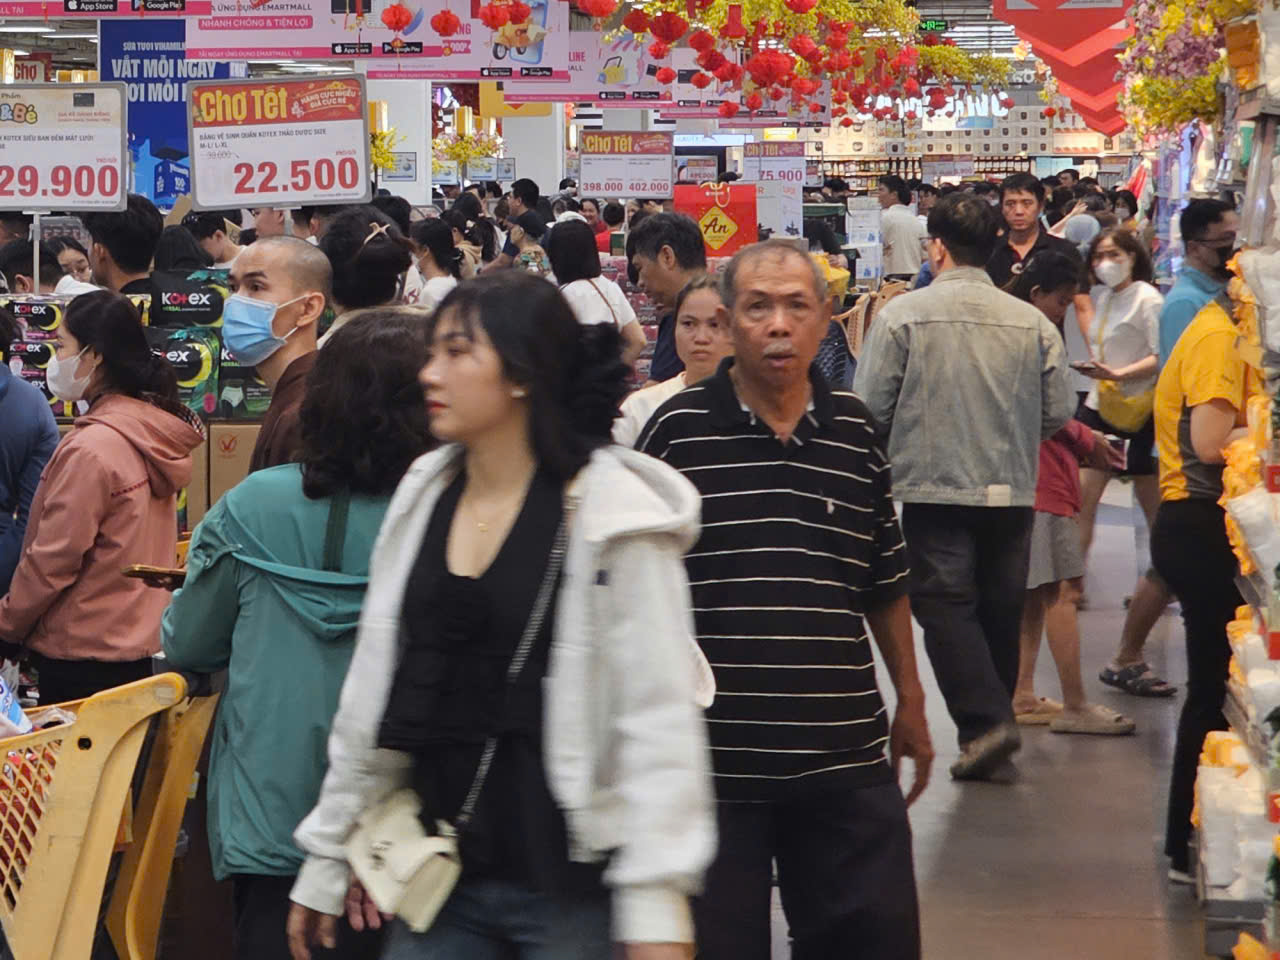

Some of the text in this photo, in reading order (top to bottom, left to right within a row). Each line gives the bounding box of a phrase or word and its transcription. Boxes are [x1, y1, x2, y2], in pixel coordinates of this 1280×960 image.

[80, 1, 114, 12] App Store
[146, 1, 168, 12] Google
[111, 54, 174, 78] VẮT MỖI
[147, 78, 179, 102] MỖI
[199, 85, 288, 125] Chợ Tết
[586, 134, 633, 154] Chợ Tết
[233, 157, 360, 195] 22.500
[583, 182, 623, 192] 398.000
[628, 182, 669, 192] 402.000
